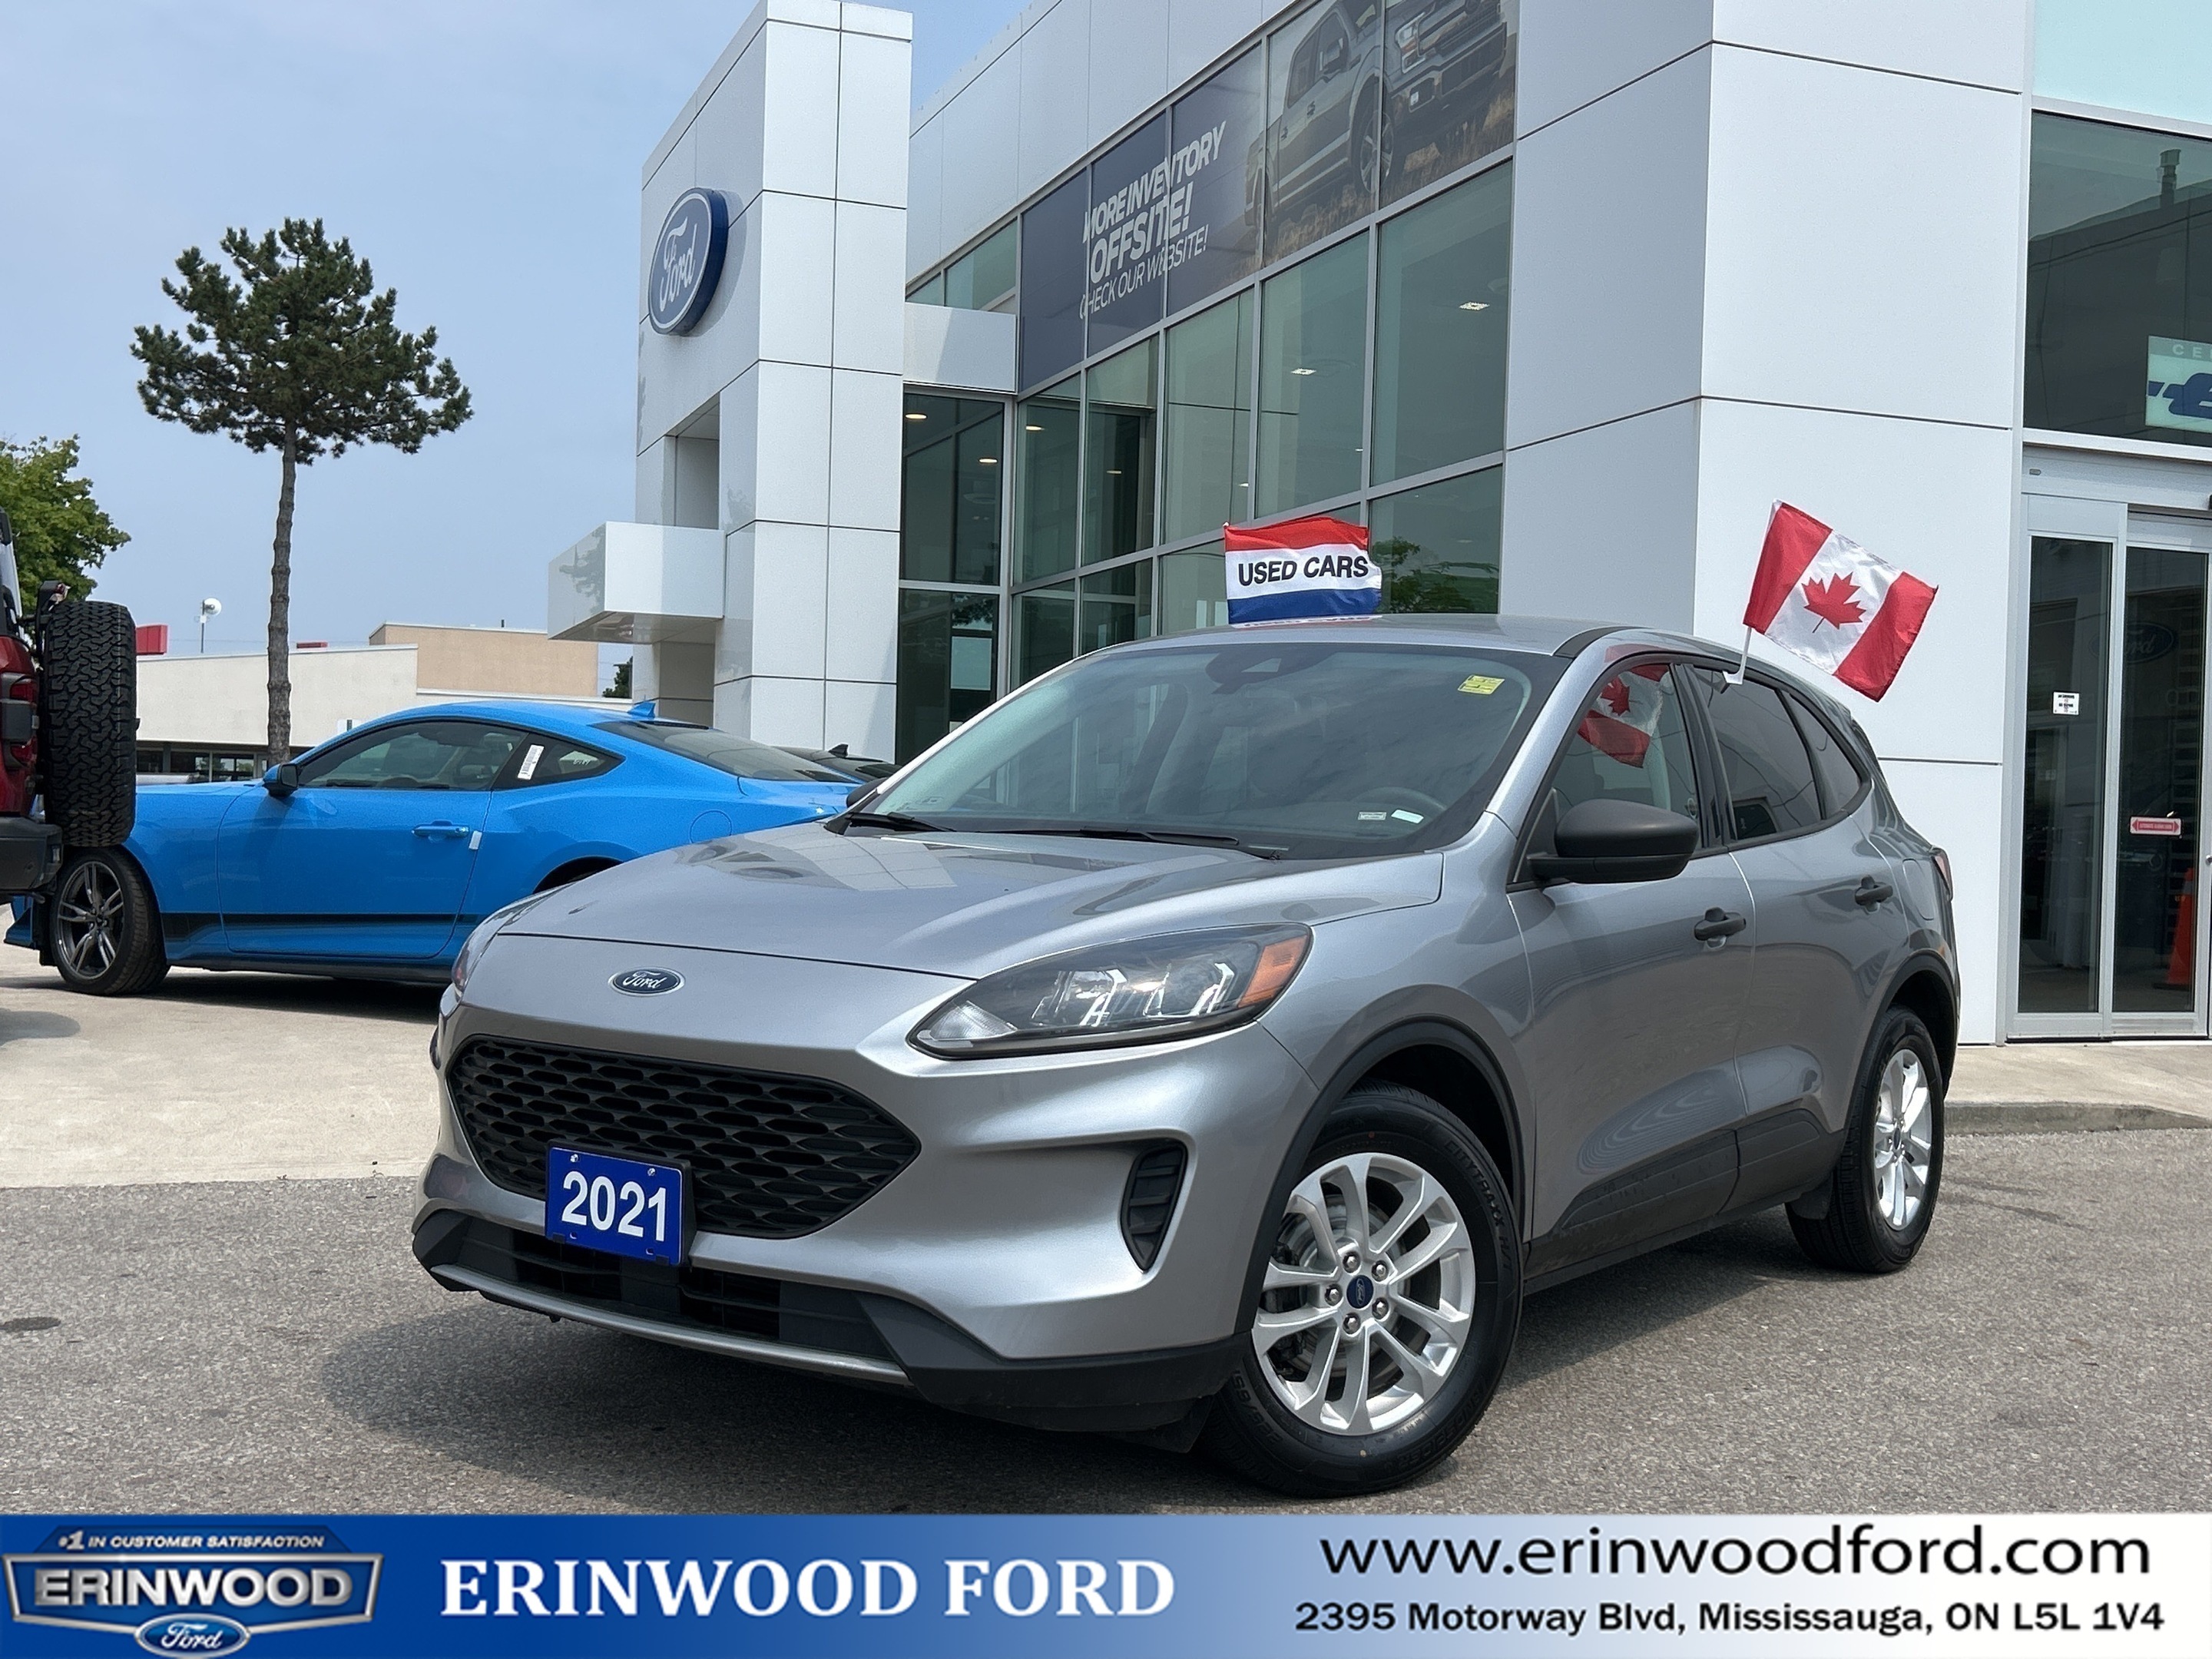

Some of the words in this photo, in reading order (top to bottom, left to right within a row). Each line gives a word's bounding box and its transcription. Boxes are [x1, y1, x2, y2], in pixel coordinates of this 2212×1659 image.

[1082, 190, 1128, 243] MORE
[1125, 120, 1227, 217] INVENTORY
[658, 216, 699, 313] Ford
[1078, 276, 1118, 320] CHECK
[1117, 263, 1146, 300] OUR
[1144, 224, 1210, 284] WEBSITE!
[1089, 180, 1194, 284] OFFSITE!
[2172, 343, 2212, 360] CE
[1237, 560, 1298, 587] USED
[1302, 555, 1369, 579] CARS
[622, 970, 667, 989] Ford
[561, 1170, 667, 1243] 2021
